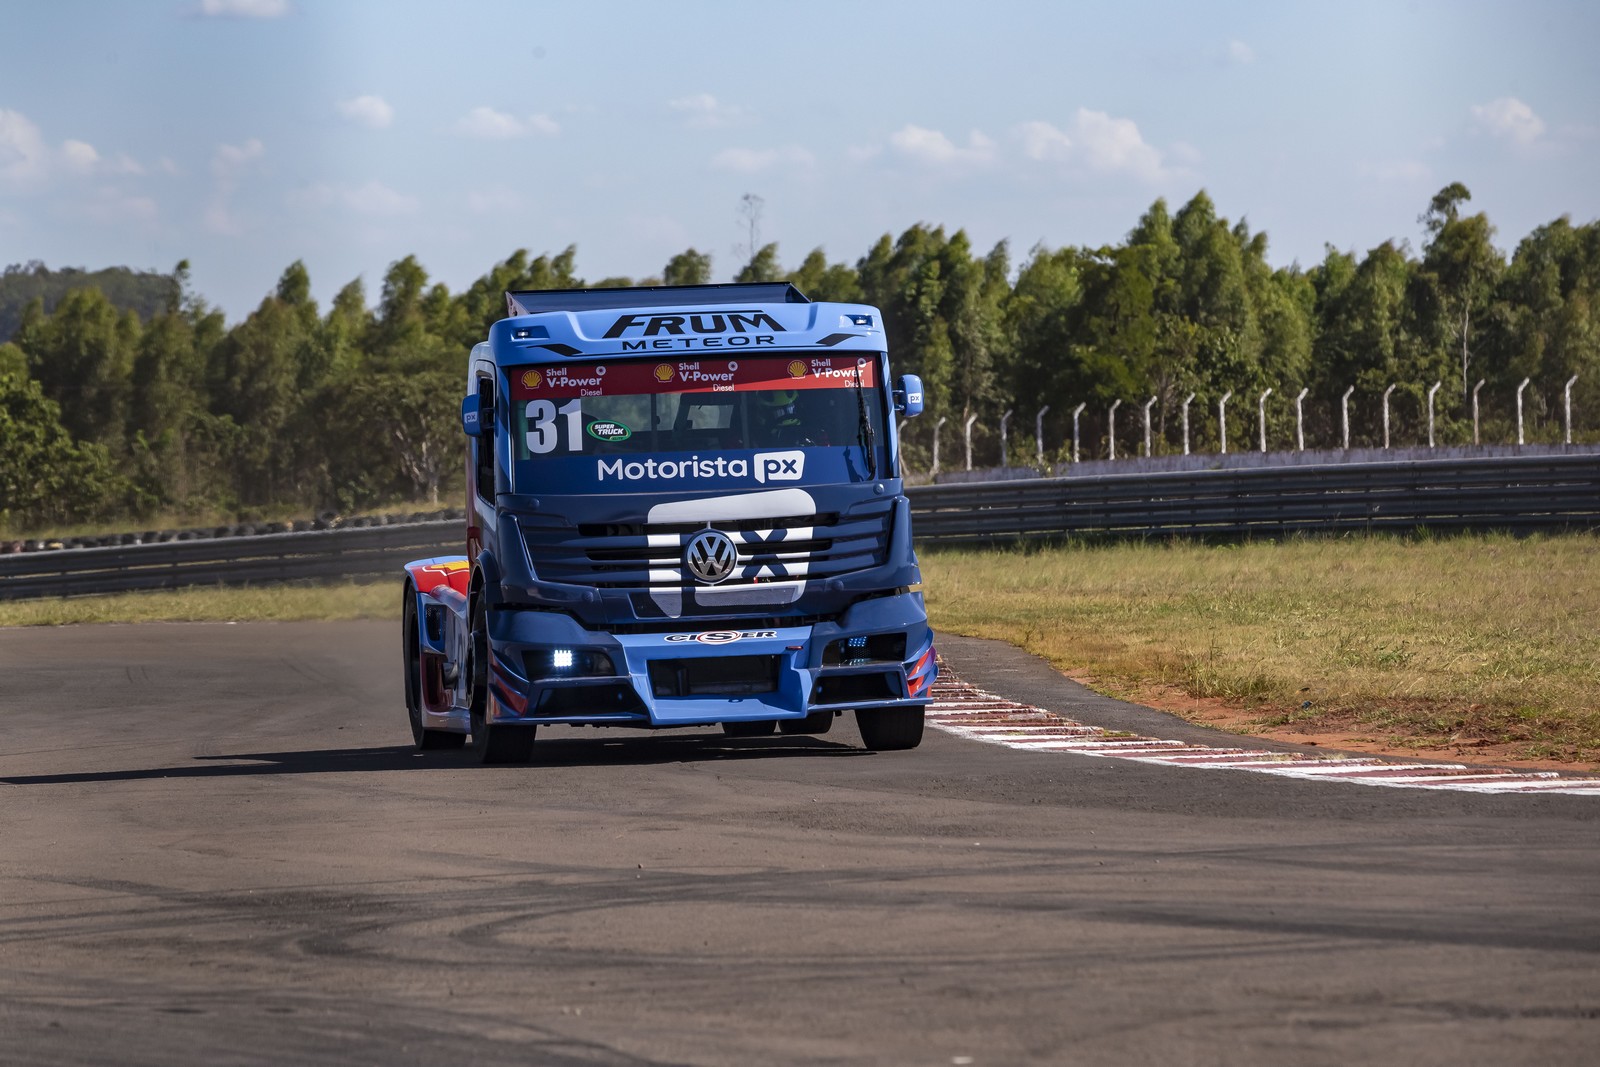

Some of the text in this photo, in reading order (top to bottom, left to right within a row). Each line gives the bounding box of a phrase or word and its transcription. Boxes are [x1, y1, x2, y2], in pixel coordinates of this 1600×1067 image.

[601, 309, 788, 339] FRUM
[621, 335, 777, 350] METEOR
[678, 362, 700, 371] Shell
[811, 358, 831, 367] Shell
[545, 367, 568, 377] Shell
[679, 370, 735, 382] V-Power
[812, 367, 864, 378] V-Power
[546, 376, 603, 388] V-Power
[713, 383, 735, 392] Diesel
[580, 387, 603, 397] Diesel
[525, 398, 583, 454] 31
[597, 428, 624, 436] TRUCK
[597, 455, 799, 483] Motorista px
[665, 630, 776, 643] CISER
